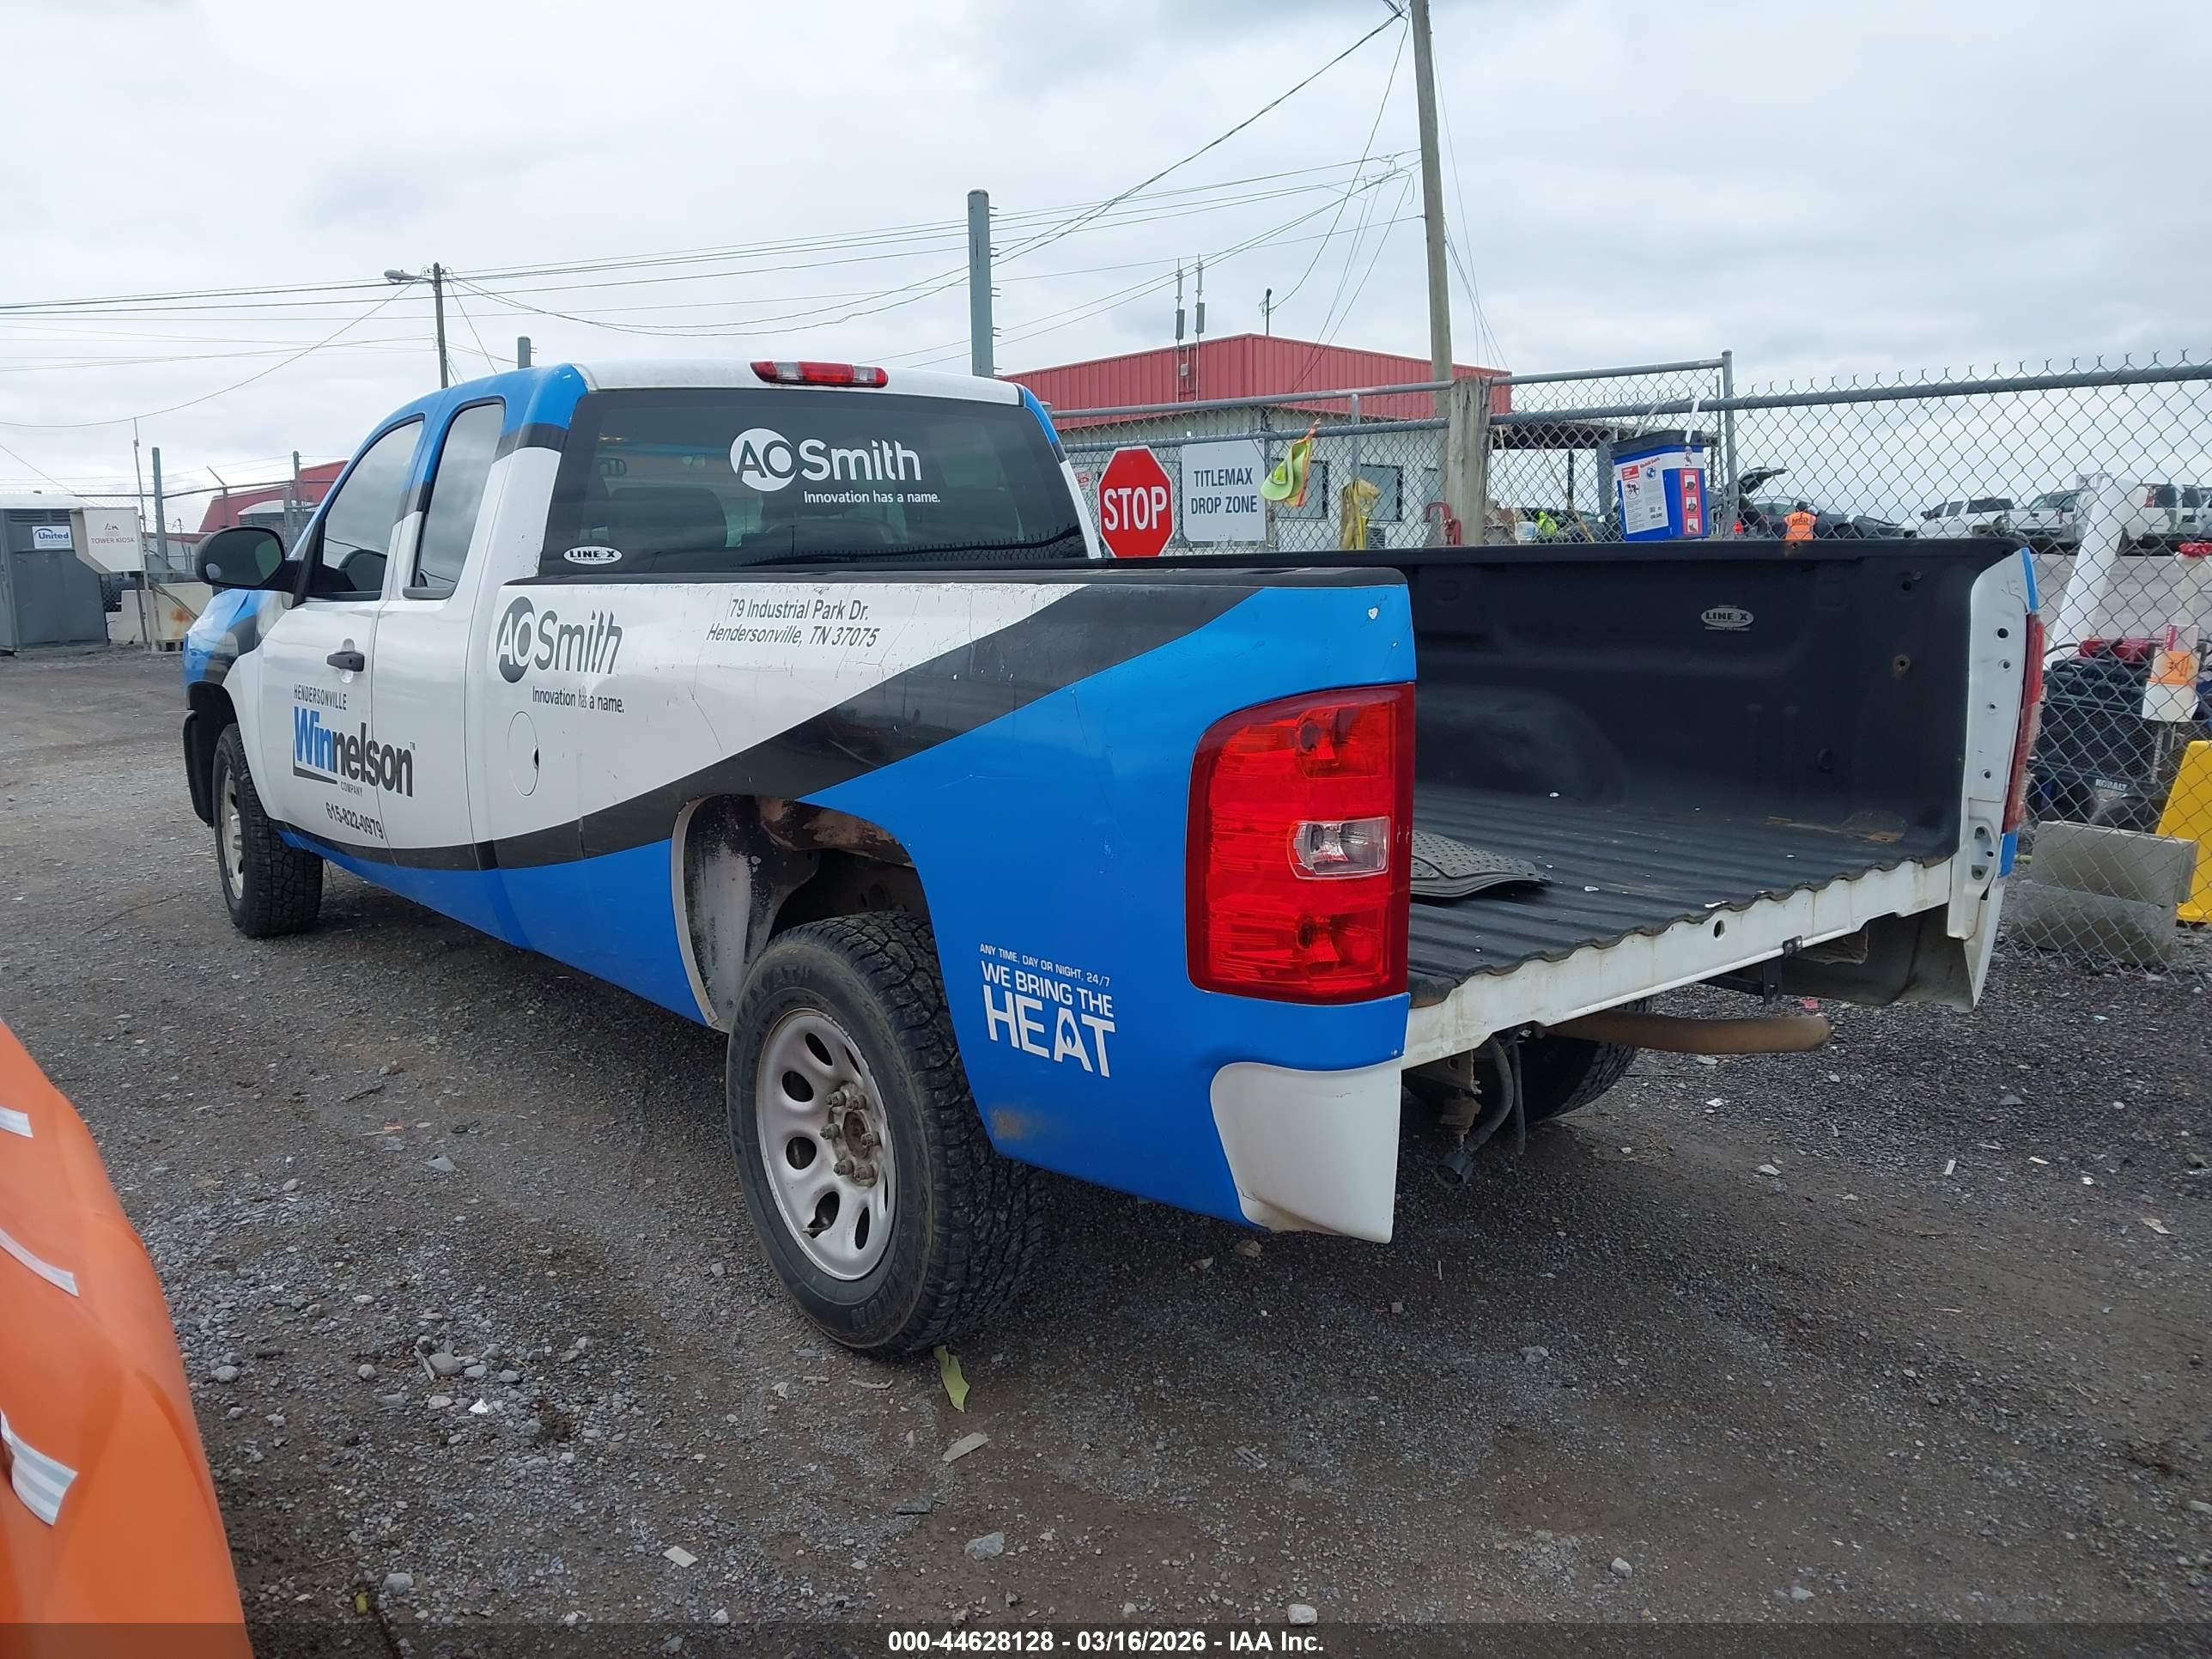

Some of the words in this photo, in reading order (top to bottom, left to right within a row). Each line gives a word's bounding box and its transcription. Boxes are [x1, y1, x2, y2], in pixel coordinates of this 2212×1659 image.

[1194, 467, 1254, 488] TITLEMAX
[804, 490, 870, 503] Innovation
[873, 490, 894, 502] has
[897, 494, 904, 502] a
[908, 493, 941, 503] name.
[1103, 486, 1168, 531] STOP
[1191, 497, 1221, 514] DROP
[1225, 495, 1258, 514] ZONE
[38, 532, 70, 540] United
[731, 599, 745, 617] 79
[747, 599, 811, 619] Industrial
[812, 599, 846, 621] Park
[848, 599, 869, 621] Dr.
[706, 623, 803, 647] Hendersonville,
[809, 625, 832, 645] TN
[831, 628, 880, 647] 37075
[294, 684, 347, 710] HENDERSONVILLE
[532, 686, 576, 707] Innovation
[578, 689, 587, 708] has
[589, 695, 595, 709] a
[597, 696, 625, 714] name.
[294, 706, 413, 798] Winnelson
[340, 781, 363, 797] COMPANY
[325, 802, 384, 840] 615-822-0979
[980, 943, 996, 956] ANY
[998, 947, 1020, 963] TIME,
[1022, 955, 1039, 967] DAY
[1040, 960, 1053, 972] OR
[1055, 963, 1084, 981] NIGHT,
[1086, 972, 1110, 988] 24/7
[981, 960, 1012, 988] WE
[1015, 970, 1073, 1006] BRING
[1076, 988, 1115, 1018] THE
[983, 984, 1116, 1079] HEAT
